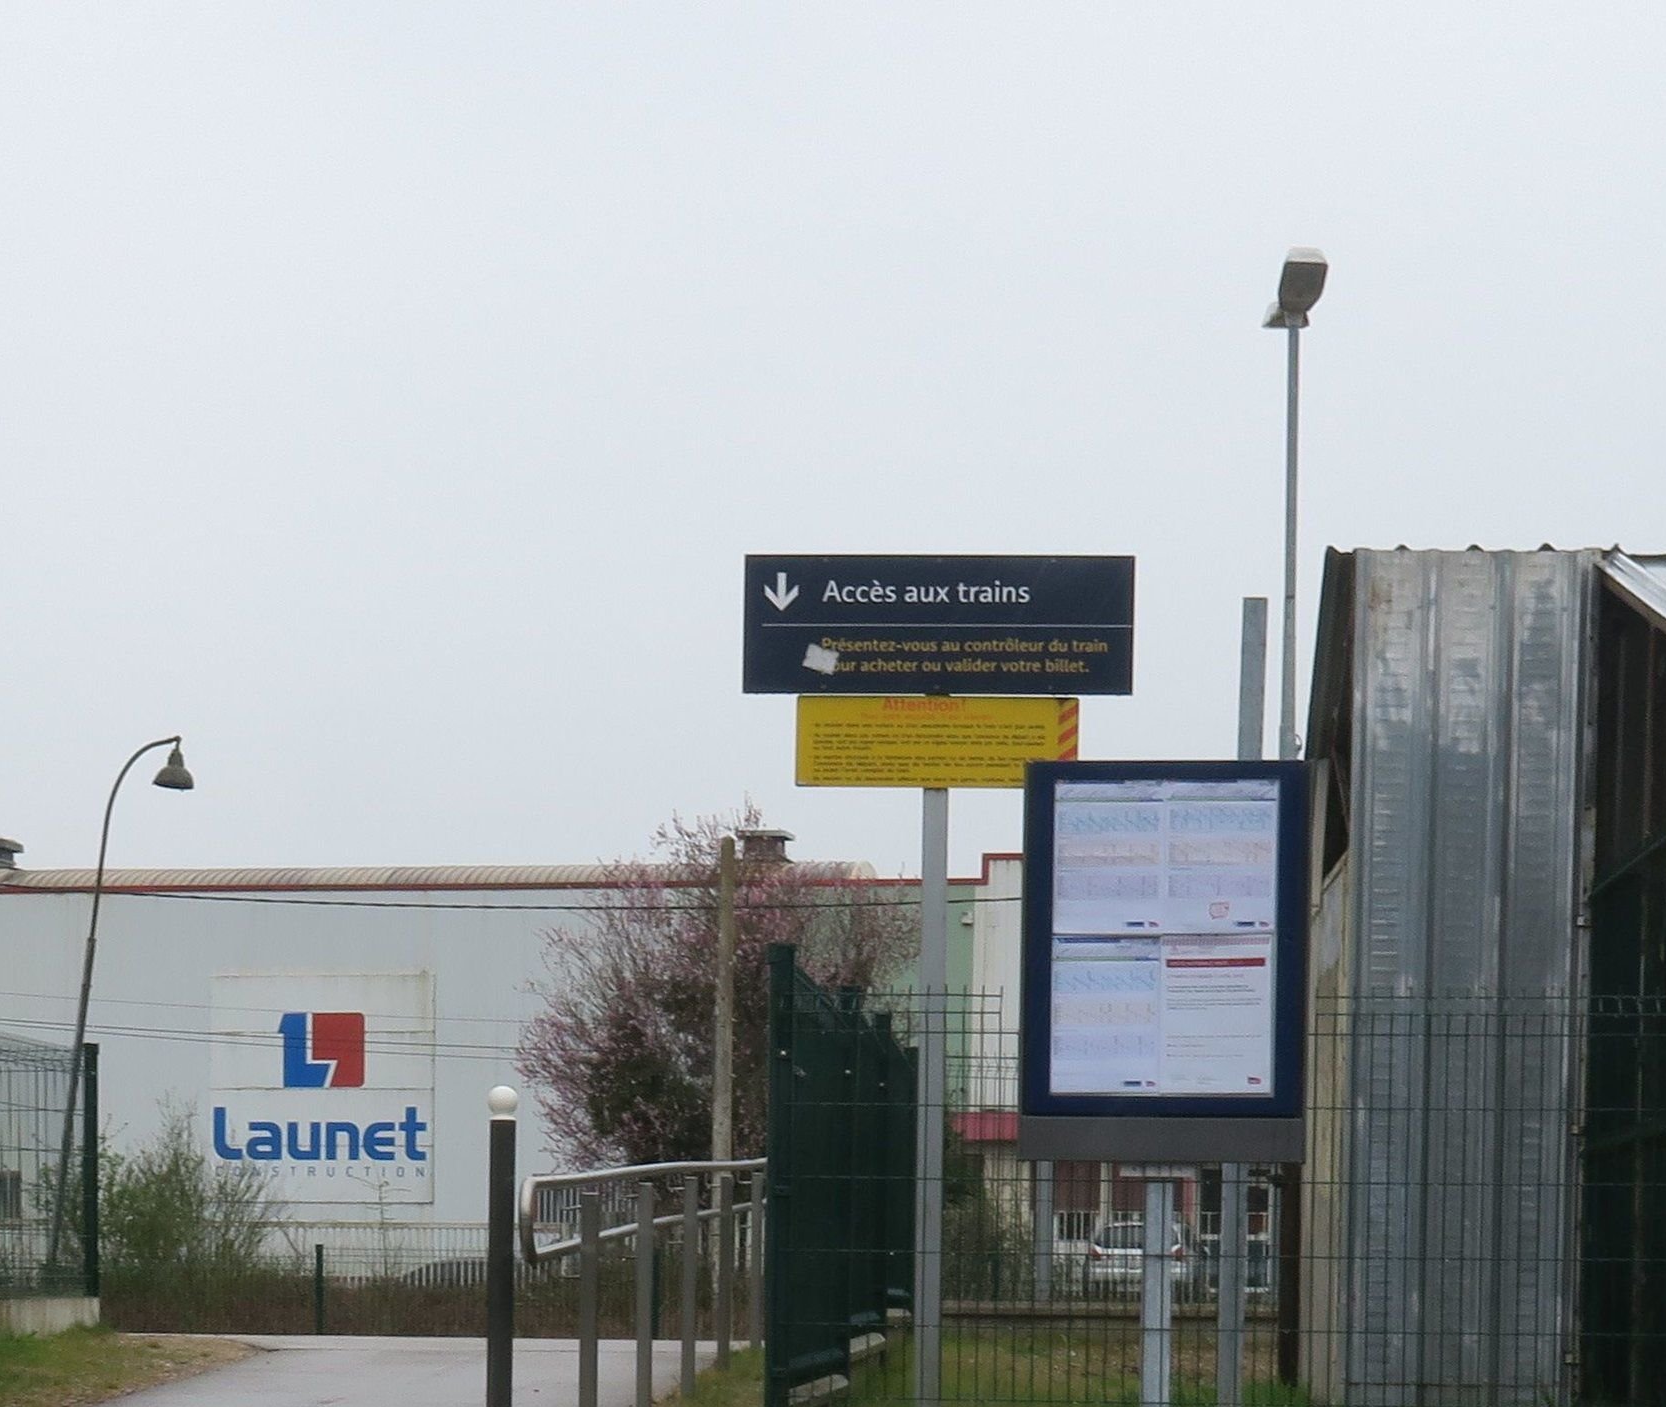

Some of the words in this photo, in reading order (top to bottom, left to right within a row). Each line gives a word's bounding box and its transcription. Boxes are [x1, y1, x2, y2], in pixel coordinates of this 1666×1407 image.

[823, 579, 897, 604] Accès
[903, 585, 949, 604] aux
[957, 580, 1031, 604] trains
[821, 637, 938, 653] Présentez-vous
[941, 640, 961, 653] au
[964, 637, 1044, 653] contrôleur
[1048, 638, 1069, 653] du
[1072, 638, 1109, 653] train
[825, 659, 855, 674] our
[860, 659, 918, 674] acheter
[922, 661, 942, 674] ou
[945, 659, 997, 674] valider
[1000, 660, 1041, 674] votre
[1045, 659, 1091, 674] billet.
[213, 1106, 428, 1161] Launet
[214, 1165, 426, 1178] CONSTRUCTION
